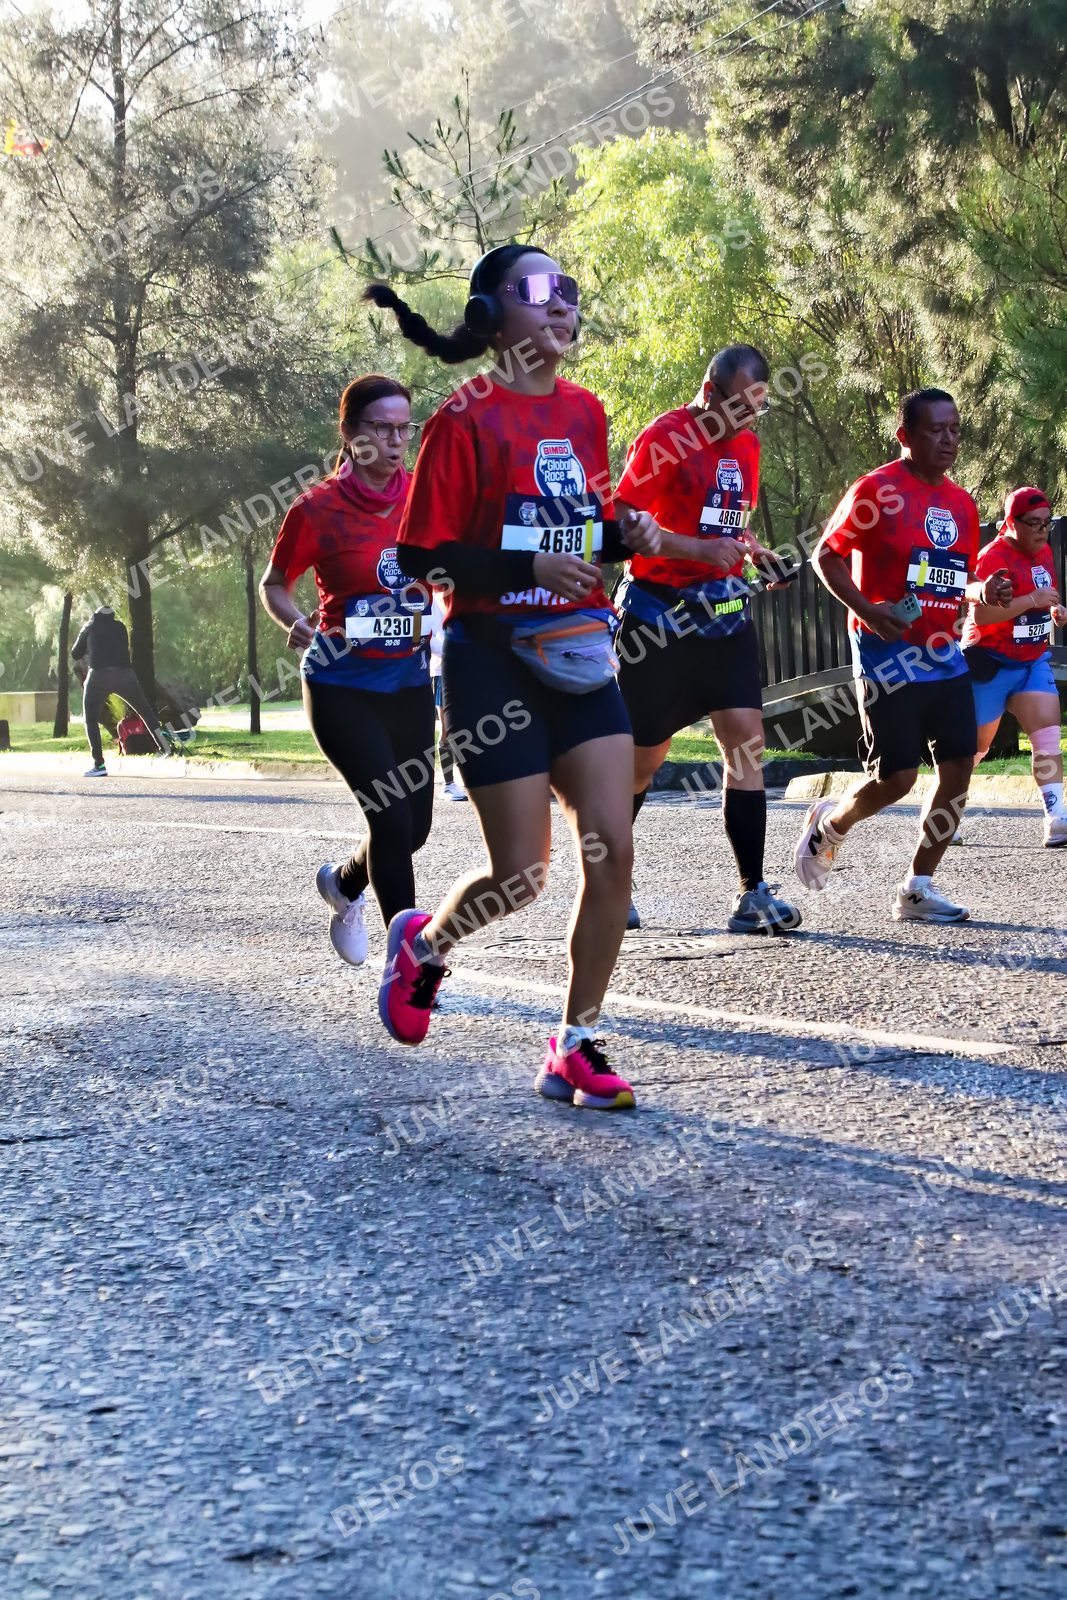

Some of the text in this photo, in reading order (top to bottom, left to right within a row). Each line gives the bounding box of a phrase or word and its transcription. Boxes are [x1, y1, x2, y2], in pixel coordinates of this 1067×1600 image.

[543, 446, 569, 455] BIMBO
[547, 459, 572, 471] Global
[544, 470, 565, 482] Race
[718, 510, 742, 527] 4860
[539, 527, 583, 553] 4638
[928, 568, 956, 586] 4859
[715, 598, 743, 616] PUMA
[373, 617, 411, 636] 4230
